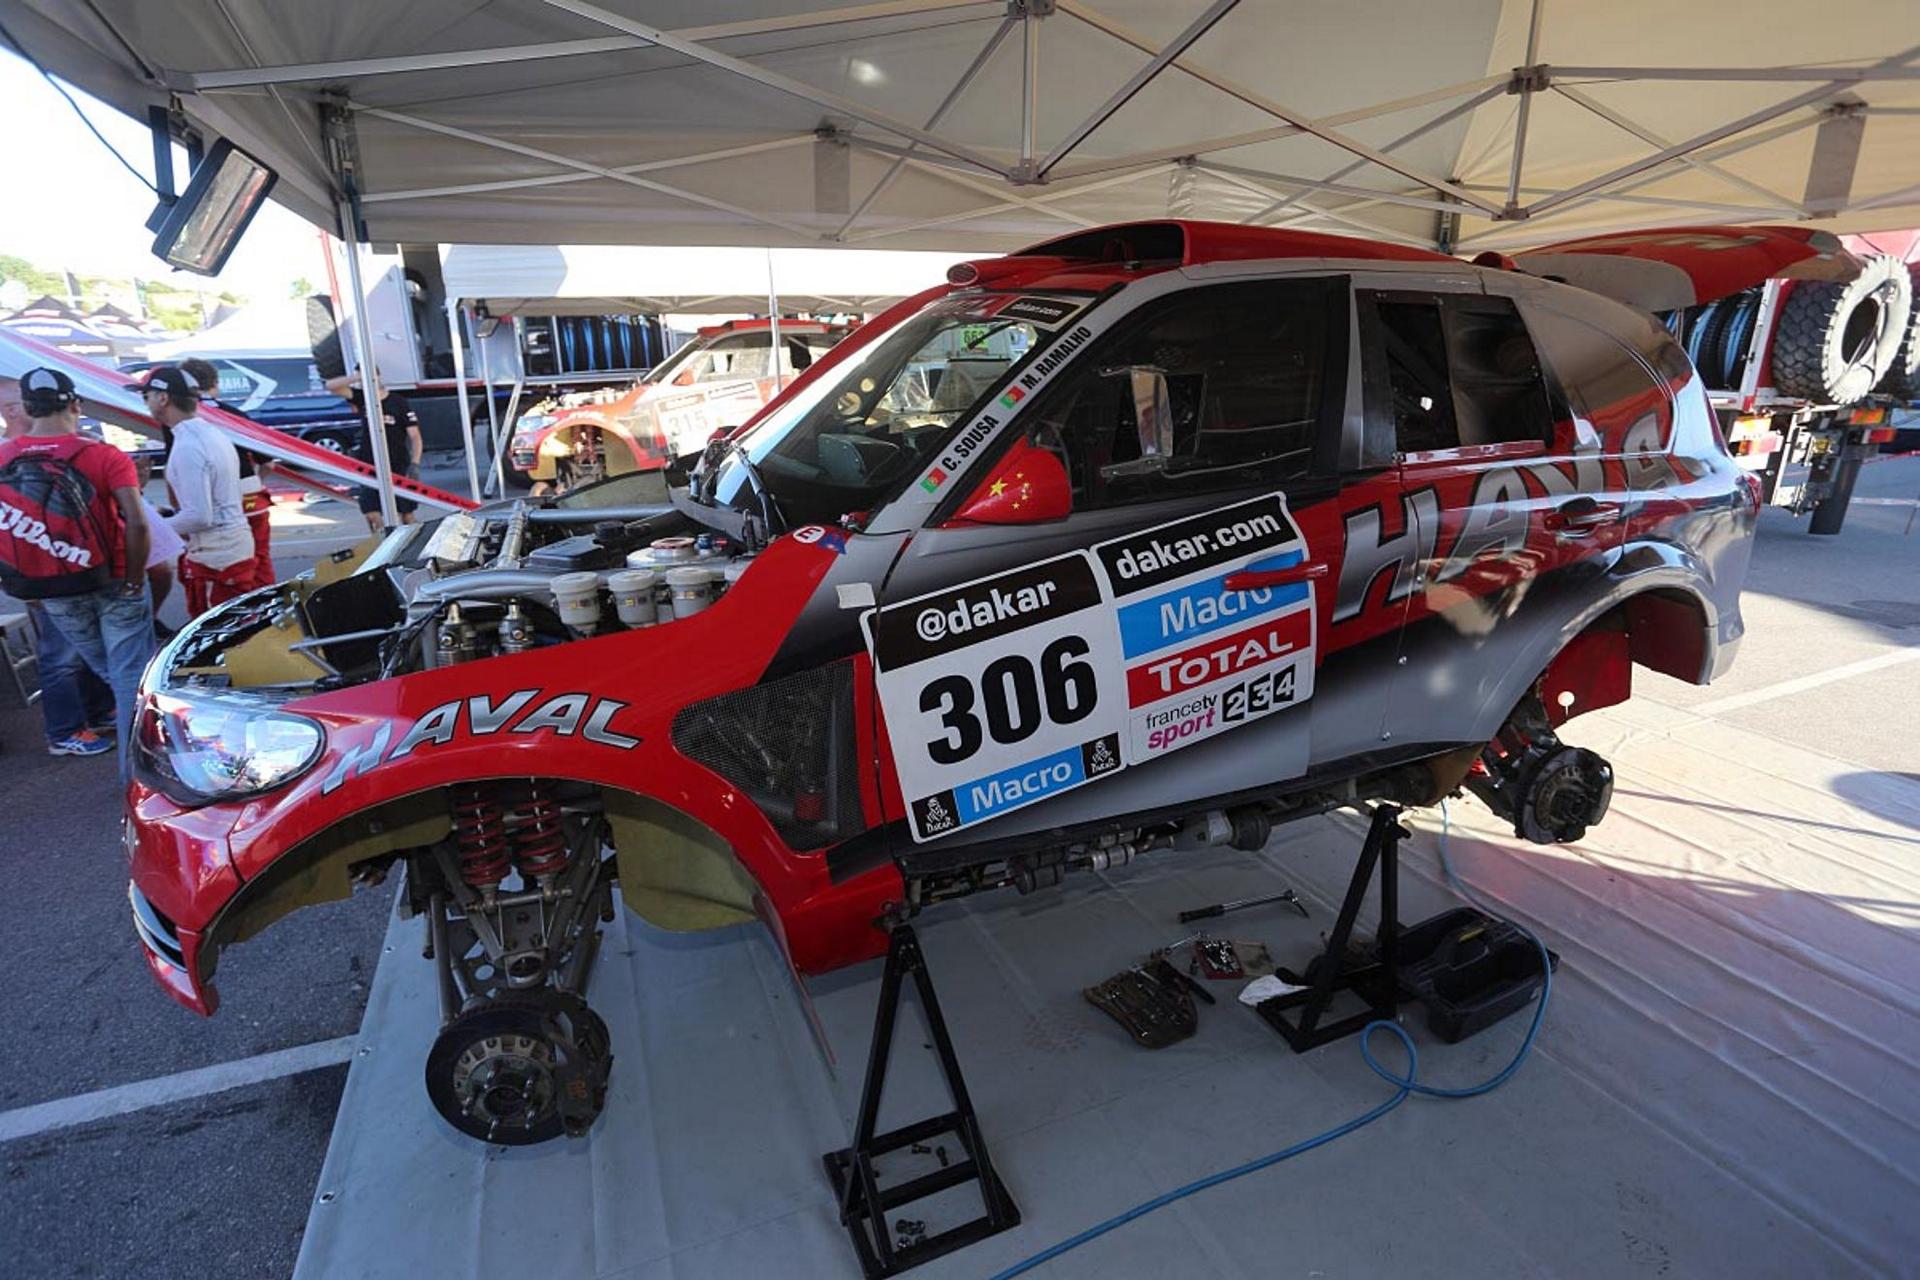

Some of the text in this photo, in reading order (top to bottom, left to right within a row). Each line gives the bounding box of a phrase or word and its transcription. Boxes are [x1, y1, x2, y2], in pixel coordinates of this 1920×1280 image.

[218, 376, 251, 389] MAHA
[1021, 326, 1092, 390] M. RAMALHO
[941, 415, 999, 472] C. SOUSA
[1116, 513, 1281, 580] dakar.com
[915, 579, 1057, 642] @dakar
[1159, 586, 1272, 638] Macro
[918, 634, 1098, 765] 306
[1146, 691, 1218, 729] francetv
[321, 688, 642, 797] HAVAL
[1148, 707, 1216, 750] sport
[971, 761, 1073, 814] Macro
